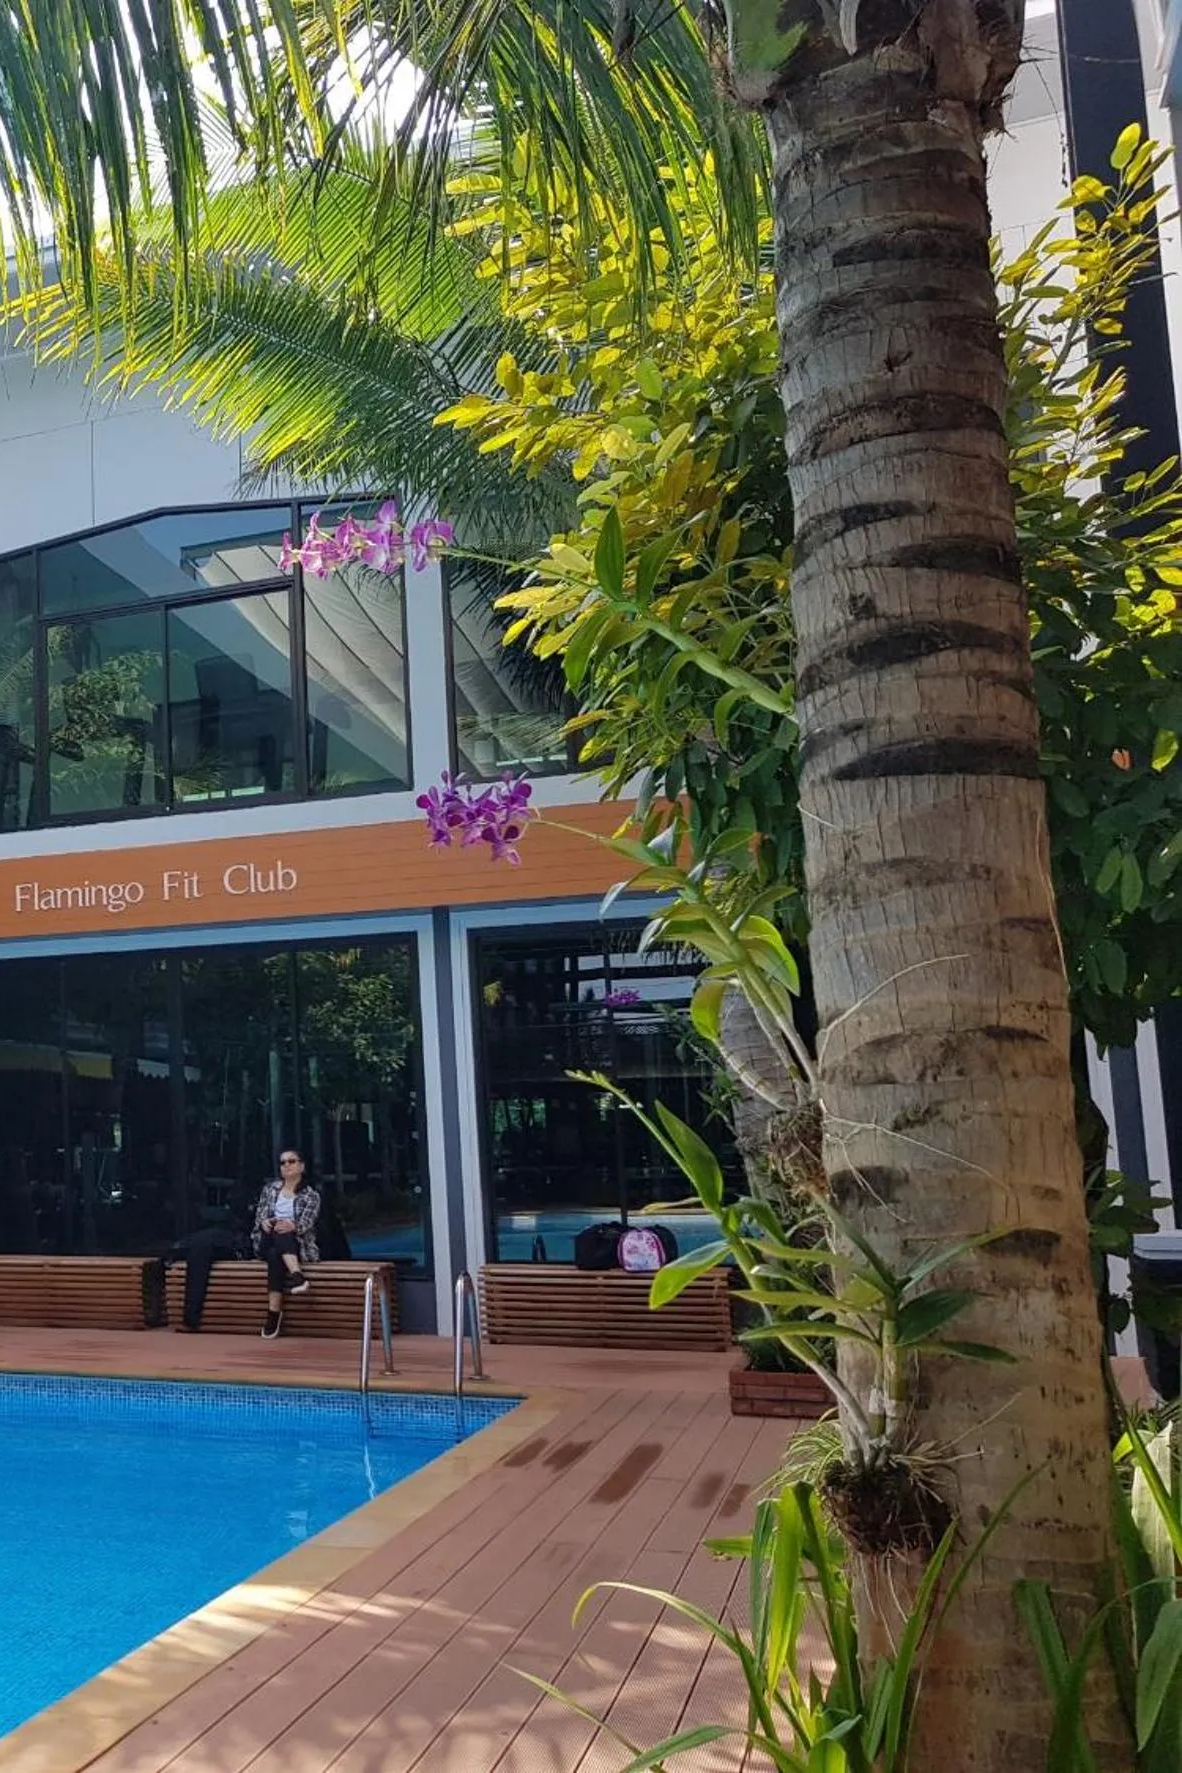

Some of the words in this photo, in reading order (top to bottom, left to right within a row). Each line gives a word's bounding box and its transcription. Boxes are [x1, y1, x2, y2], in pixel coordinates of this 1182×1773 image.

[15, 880, 144, 912] Flamingo
[163, 871, 203, 900] Fit
[223, 860, 298, 894] Club
